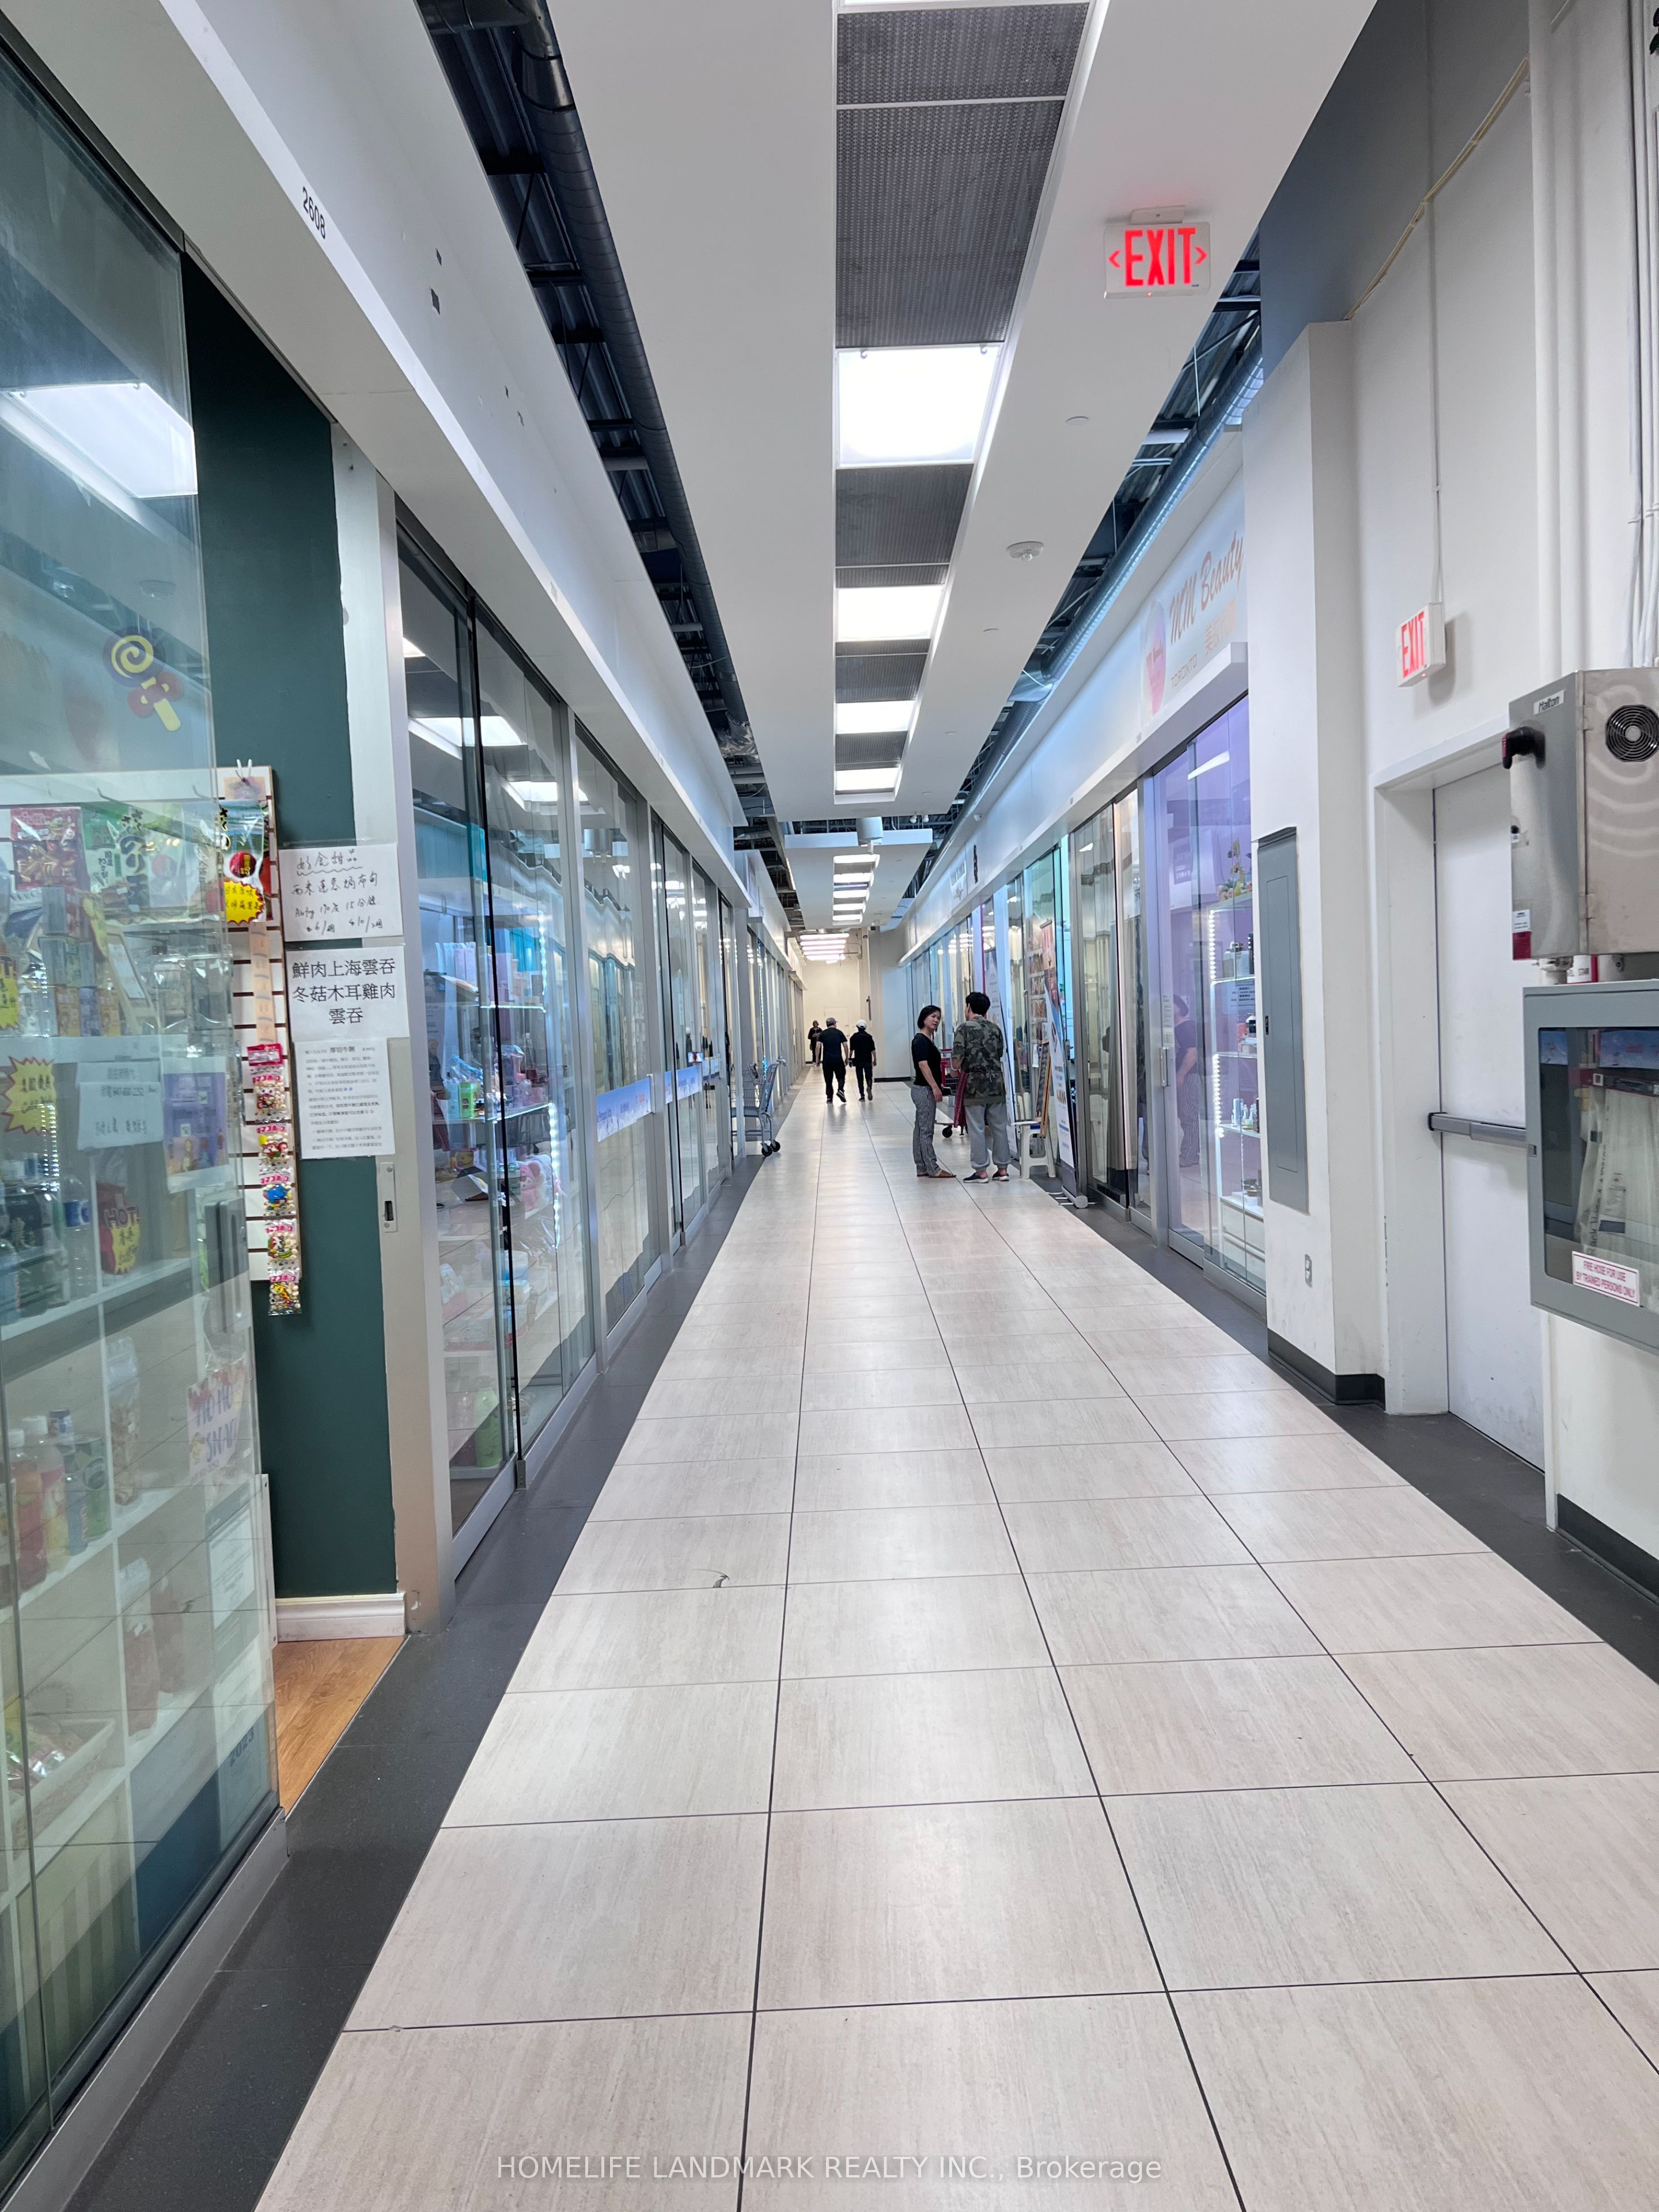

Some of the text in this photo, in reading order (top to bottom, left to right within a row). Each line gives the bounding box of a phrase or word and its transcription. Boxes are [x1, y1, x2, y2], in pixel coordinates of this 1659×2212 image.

[302, 186, 326, 239] 2608
[1124, 227, 1196, 287] EXIT
[1200, 530, 1244, 612] Beauty
[1402, 611, 1426, 679] EXIT
[1171, 653, 1198, 689] TORONTO
[1539, 696, 1560, 713] Halton
[292, 958, 395, 979] 鮮肉上海雲吞
[292, 983, 395, 1003] 冬菇木耳雞肉
[328, 1007, 363, 1025] 雲吞
